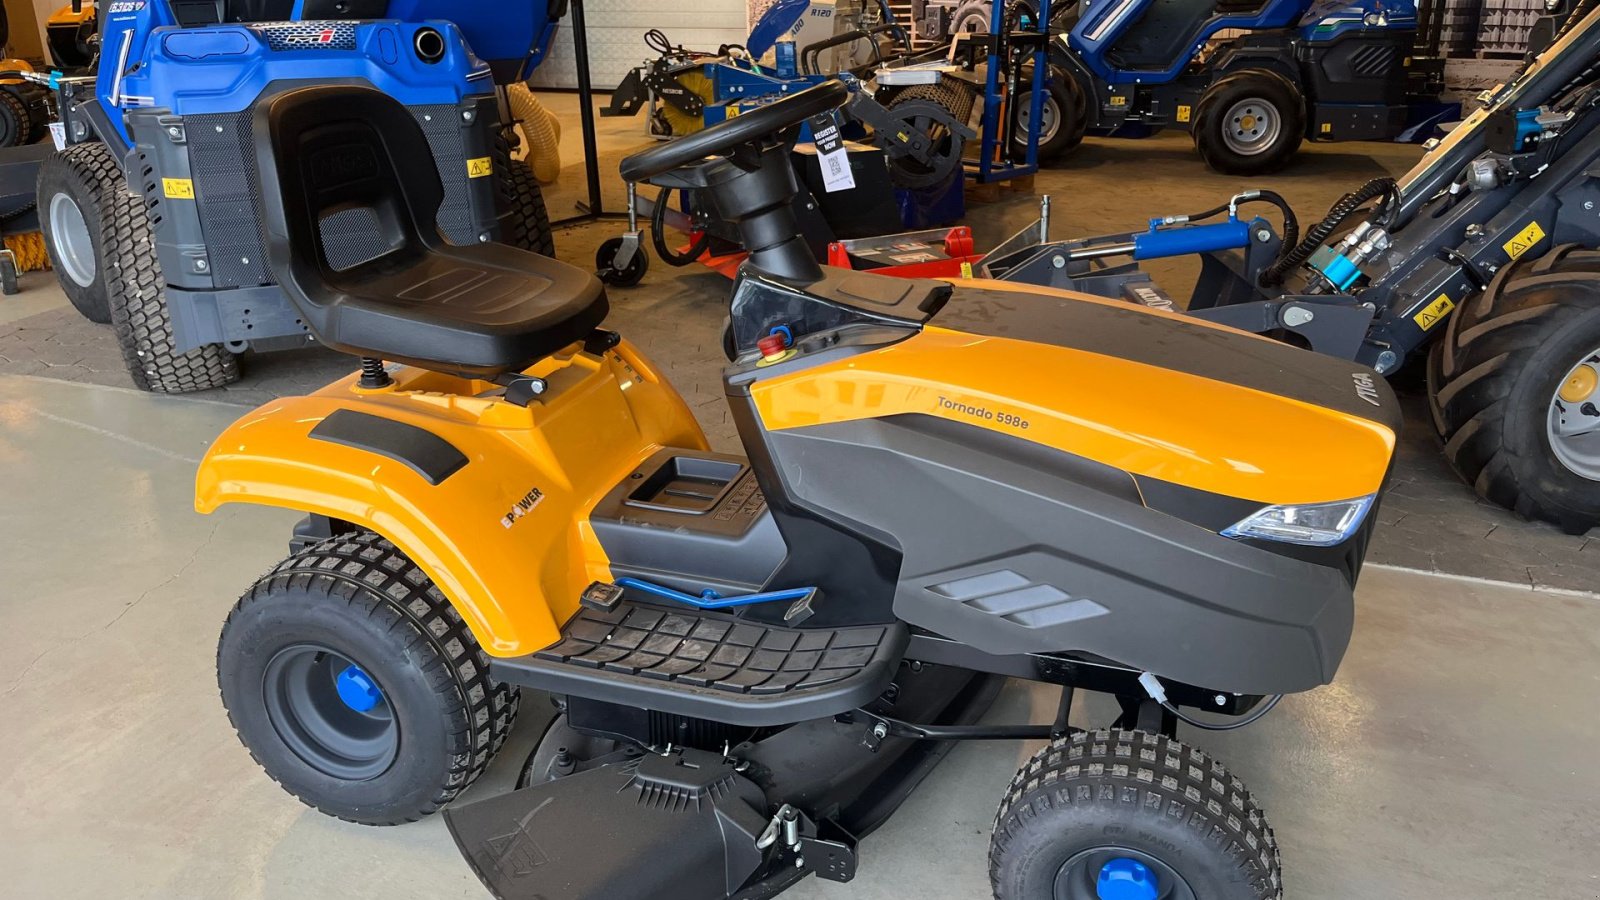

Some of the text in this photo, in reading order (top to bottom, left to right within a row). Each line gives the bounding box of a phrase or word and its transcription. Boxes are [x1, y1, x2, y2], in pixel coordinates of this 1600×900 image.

[811, 8, 831, 18] R120
[814, 125, 837, 141] REGISTER
[823, 140, 837, 151] NOW
[938, 396, 1029, 429] Tornado 598e
